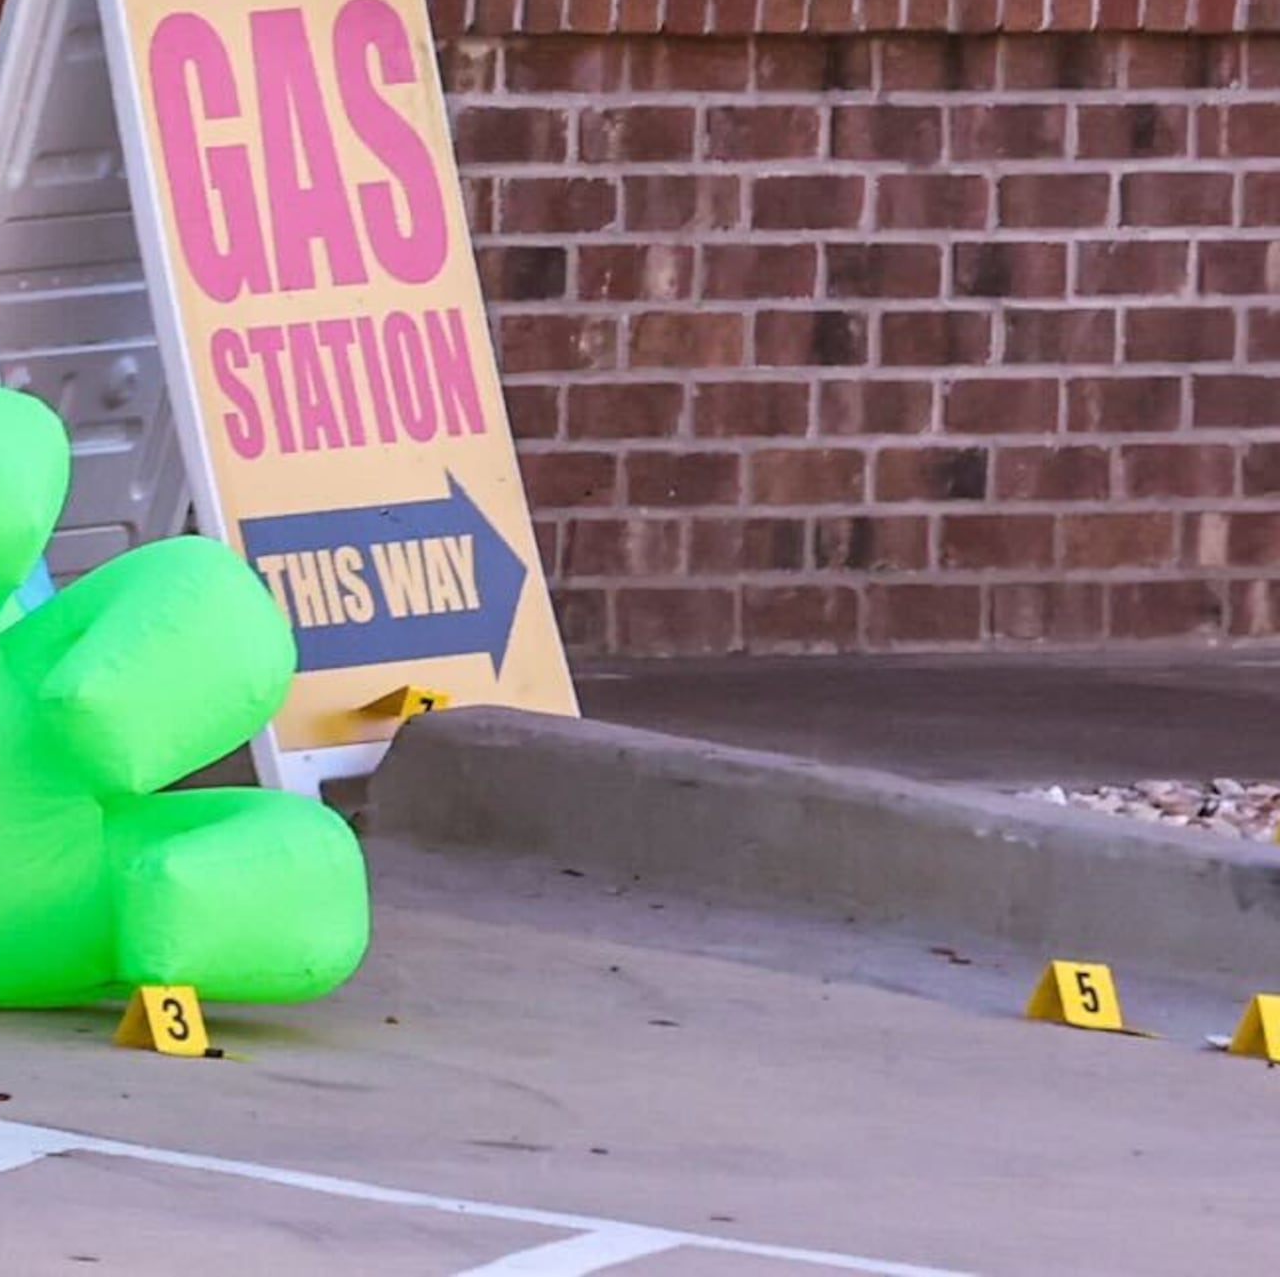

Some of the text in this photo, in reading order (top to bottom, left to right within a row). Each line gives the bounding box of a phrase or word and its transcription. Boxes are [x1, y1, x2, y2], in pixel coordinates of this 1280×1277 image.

[209, 307, 487, 461] STATION
[257, 535, 481, 629] THIS WAY
[162, 997, 190, 1042] 3
[1076, 970, 1100, 1014] 5
